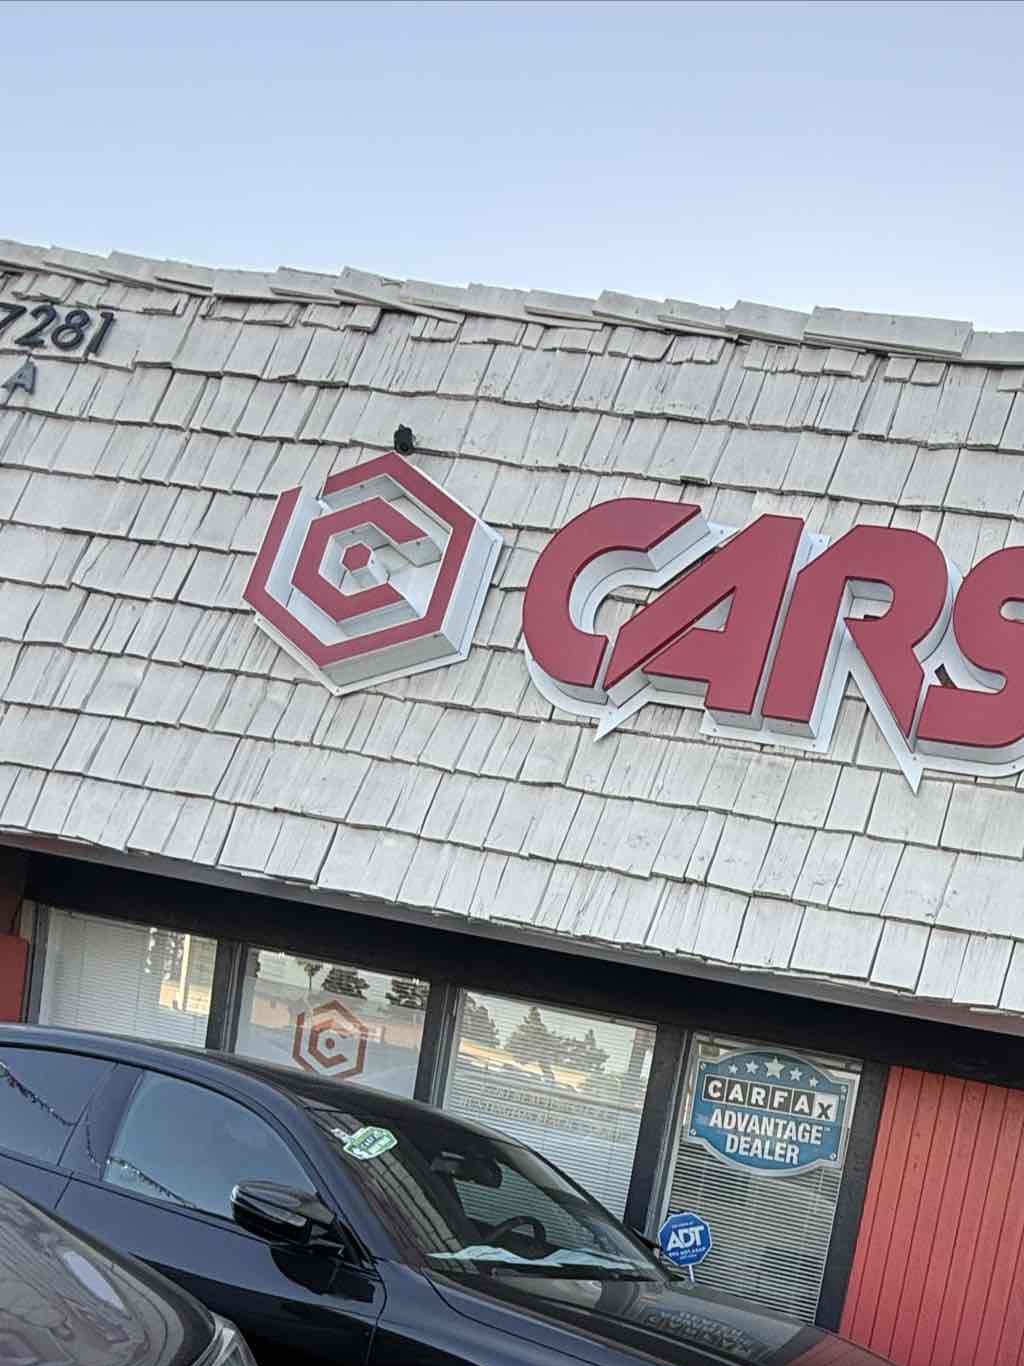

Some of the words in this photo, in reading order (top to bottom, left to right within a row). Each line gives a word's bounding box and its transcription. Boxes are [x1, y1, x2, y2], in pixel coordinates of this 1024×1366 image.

[0, 302, 115, 353] 7281
[1, 361, 36, 394] A
[707, 1079, 834, 1121] CARFAX
[709, 1108, 823, 1145] ADVANTAGE
[725, 1133, 801, 1165] DEALER
[667, 1225, 705, 1250] ADT
